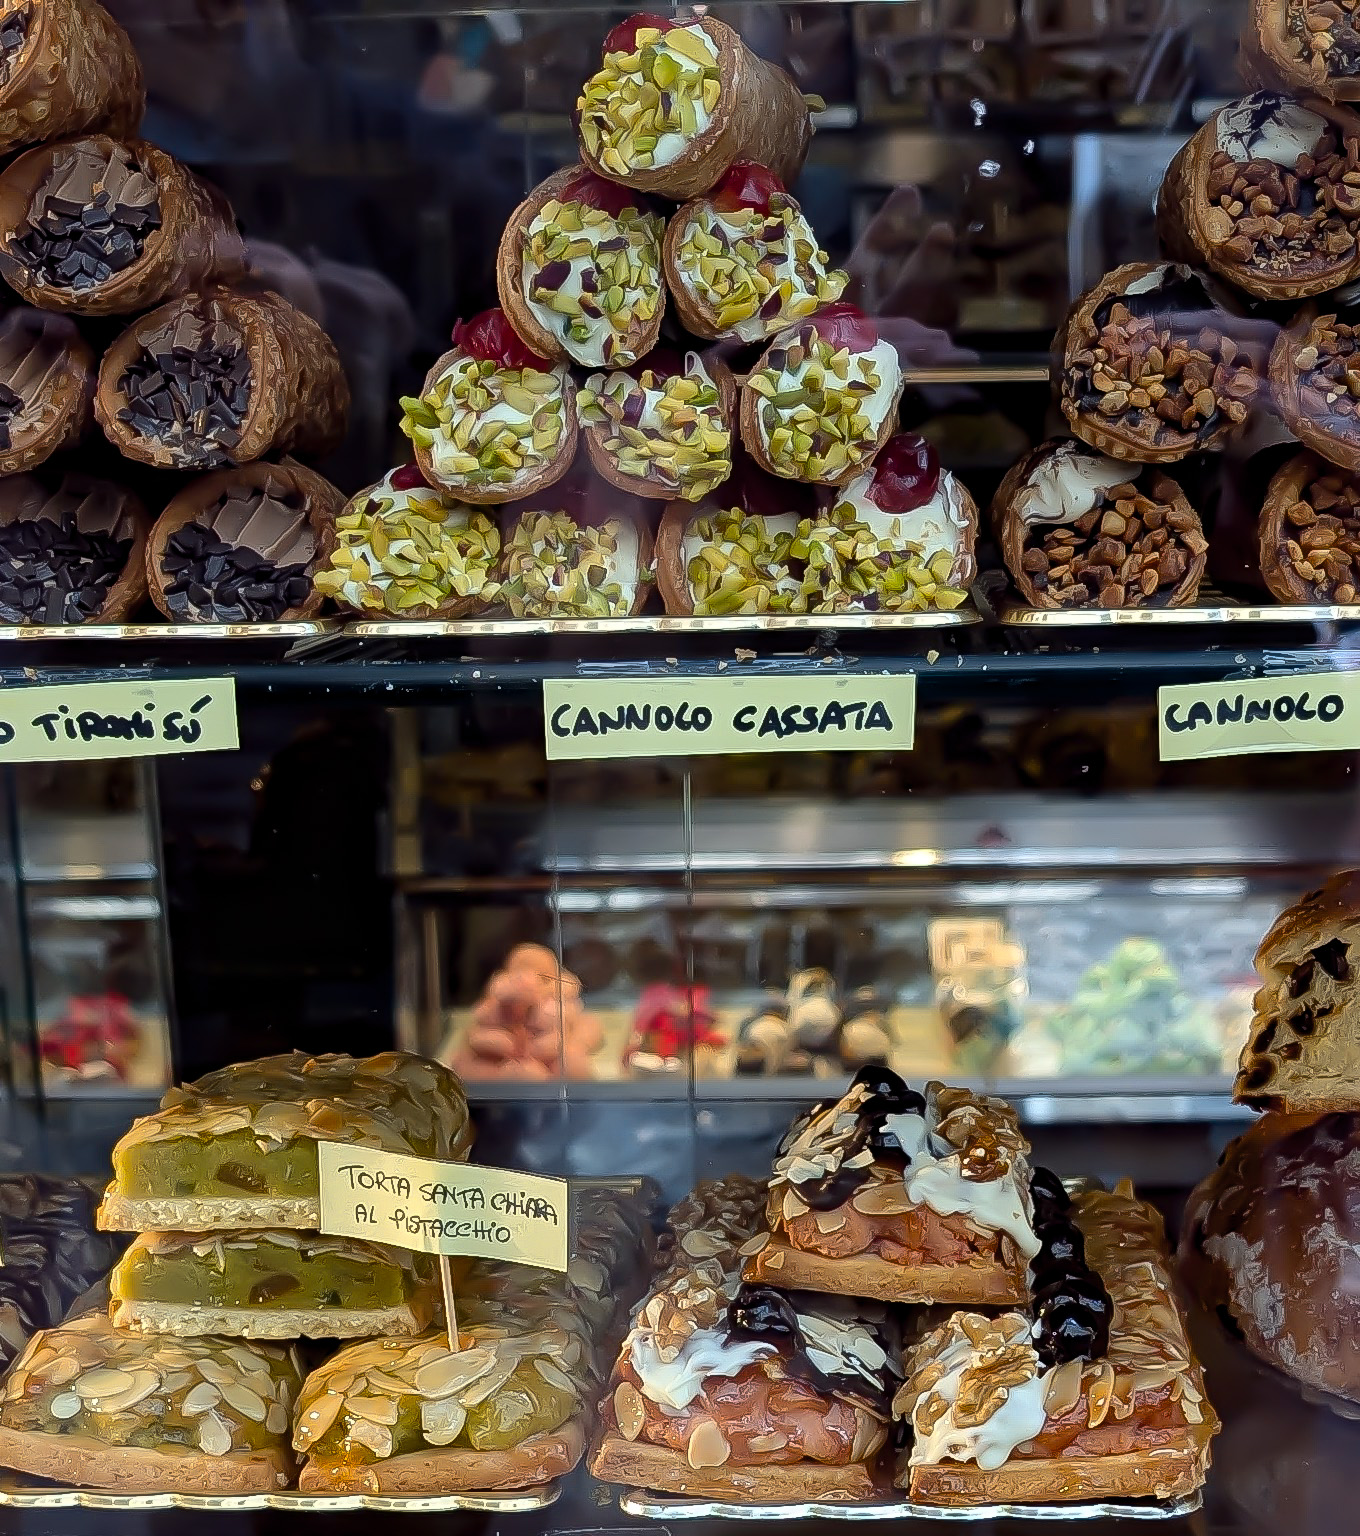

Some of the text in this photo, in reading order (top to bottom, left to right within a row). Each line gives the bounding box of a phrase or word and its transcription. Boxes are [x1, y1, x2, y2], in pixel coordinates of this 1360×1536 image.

[731, 699, 894, 740] CASSATA
[337, 1164, 411, 1200] TORTA
[418, 1182, 486, 1210] SANTA
[354, 1203, 378, 1225] AL
